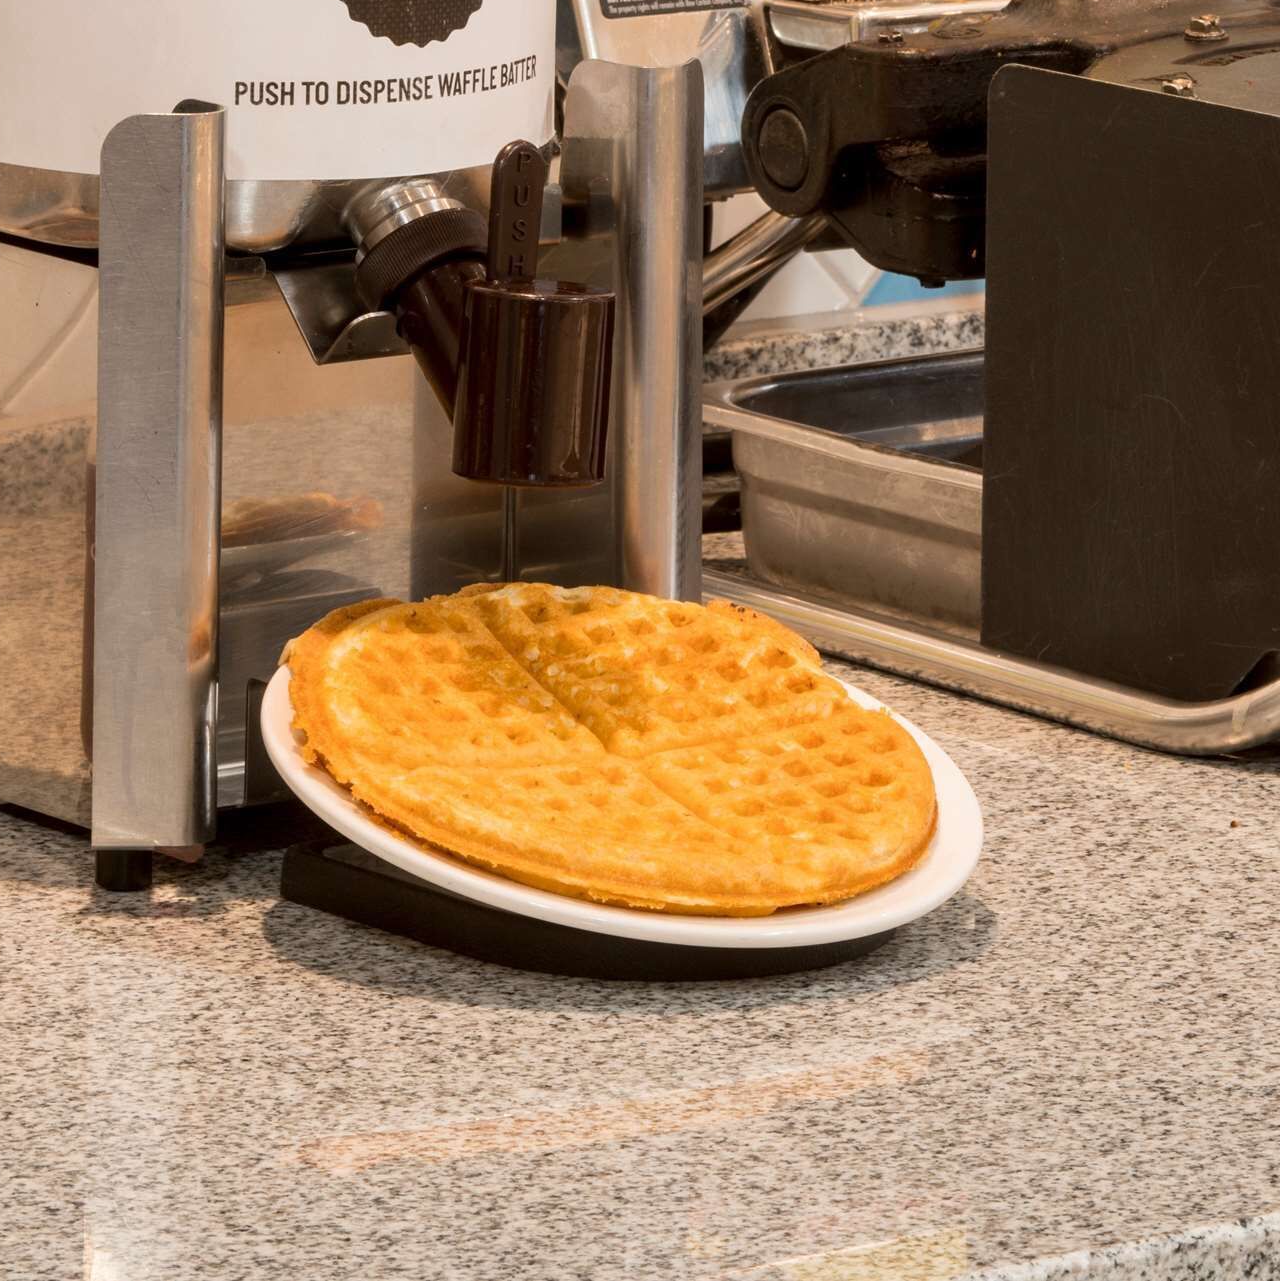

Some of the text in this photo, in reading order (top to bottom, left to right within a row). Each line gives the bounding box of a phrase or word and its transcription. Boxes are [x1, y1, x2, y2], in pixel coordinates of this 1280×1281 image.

[234, 54, 537, 106] PUSH TO DISPENSE WAFFLE BATTER
[507, 151, 531, 277] PUSH
